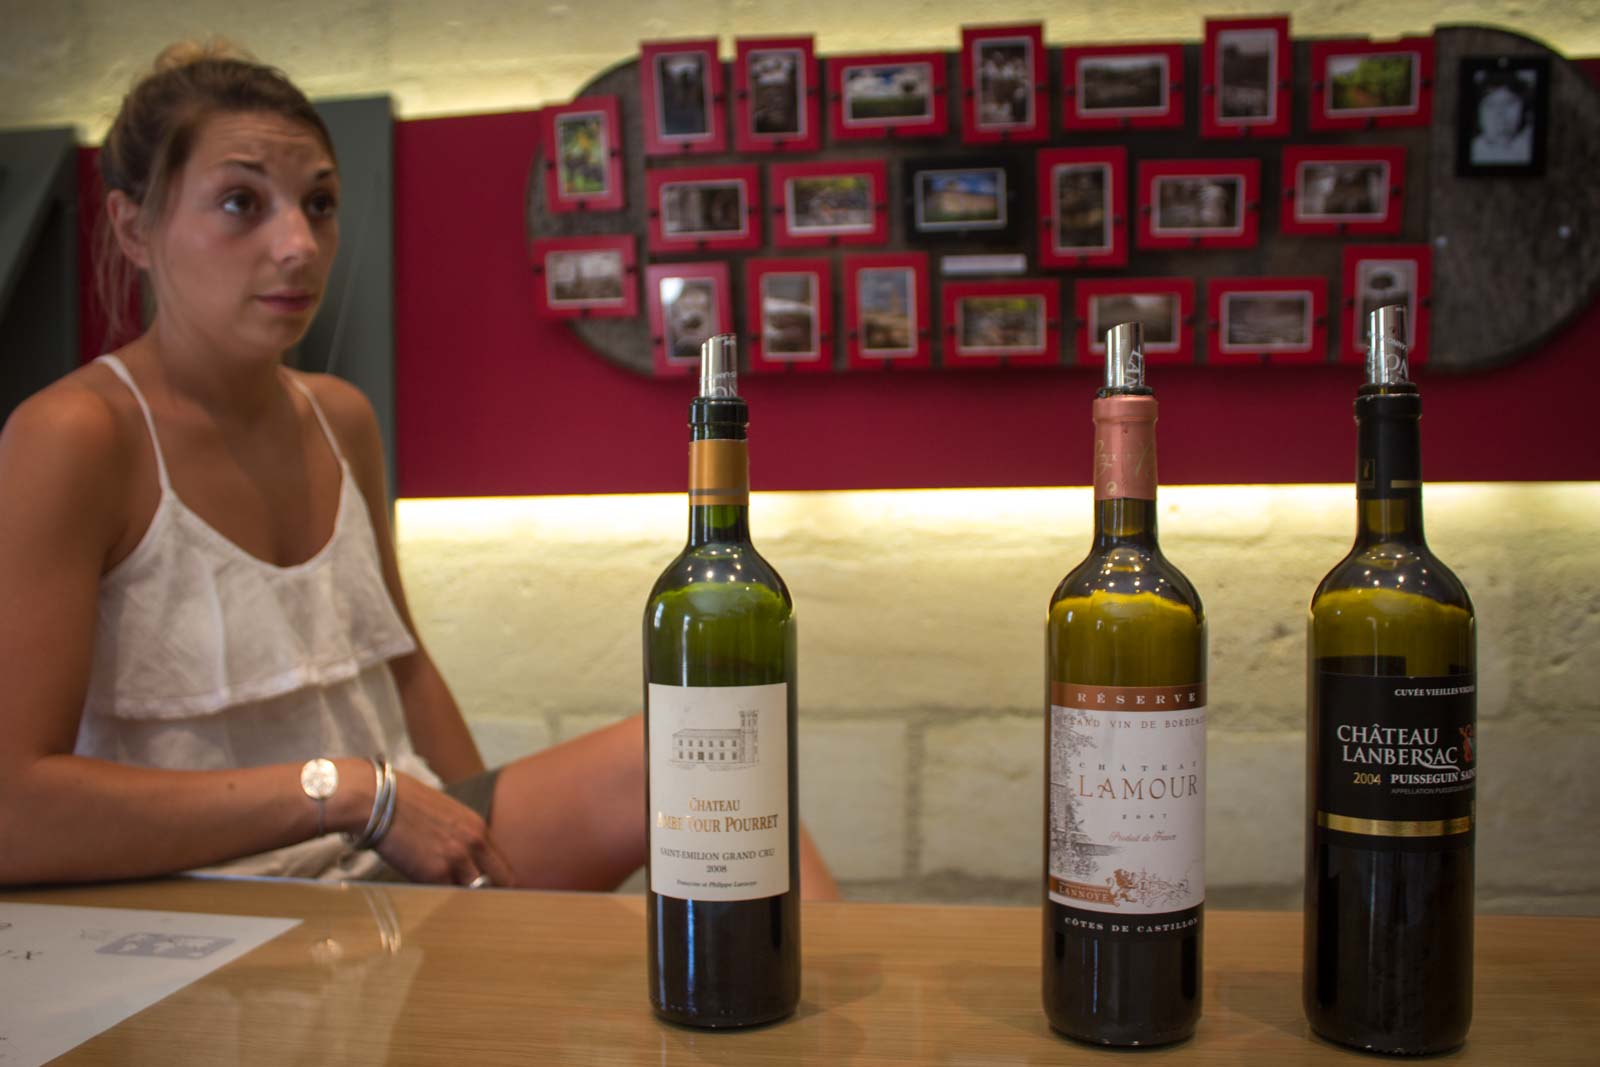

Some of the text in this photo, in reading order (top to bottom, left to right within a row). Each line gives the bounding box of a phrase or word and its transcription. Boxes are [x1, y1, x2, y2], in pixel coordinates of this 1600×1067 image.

[1077, 692, 1196, 705] RÉSERVE
[1395, 688, 1424, 697] CUVÉE
[1426, 687, 1459, 696] VIEILLES
[1110, 719, 1131, 729] VIN
[1141, 720, 1156, 729] DE
[1165, 716, 1203, 728] BORDEA
[1337, 723, 1439, 746] CHÂTEAU
[1342, 745, 1460, 771] LANBERSAC
[1353, 772, 1381, 785] 2004
[1391, 771, 1458, 784] PUISSEGUIN
[1079, 774, 1198, 800] LAMOUR
[725, 814, 778, 832] POURRET
[722, 850, 756, 861] GRAND
[758, 848, 775, 858] CRU
[706, 865, 728, 873] 2008
[1064, 916, 1104, 931] CÔTES
[1112, 923, 1129, 933] DE
